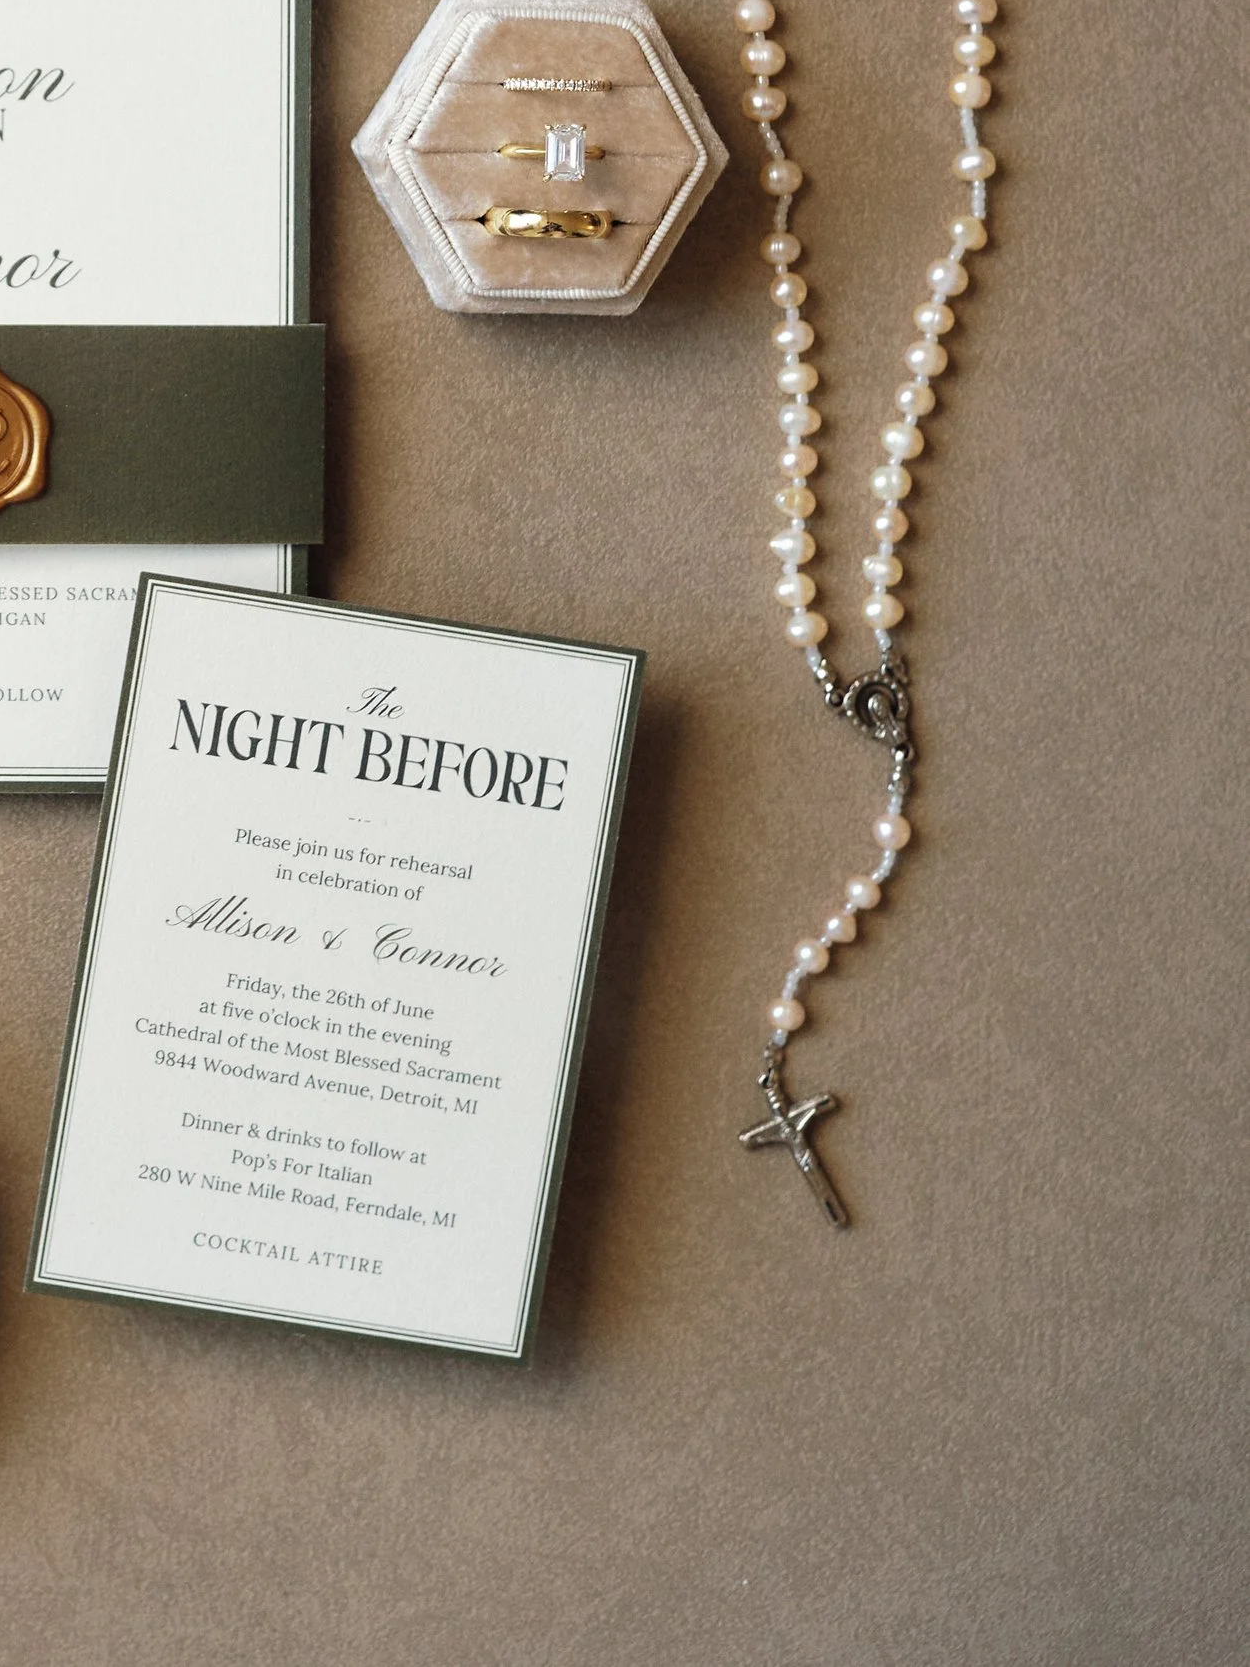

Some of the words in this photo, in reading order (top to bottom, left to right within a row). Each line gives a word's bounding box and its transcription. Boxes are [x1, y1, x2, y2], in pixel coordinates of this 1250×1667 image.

[345, 685, 405, 720] The
[168, 698, 345, 775] NIGHT
[353, 727, 569, 812] BEFORE
[234, 828, 292, 852] Please
[292, 837, 328, 858] join
[334, 847, 354, 862] us
[358, 847, 387, 866] for
[389, 854, 473, 880] rehearsal
[275, 863, 293, 881] in
[297, 870, 399, 898] celebration
[403, 885, 425, 902] of
[164, 894, 302, 945] Allison
[322, 927, 348, 950] &
[372, 923, 507, 978] Connor
[226, 972, 286, 1001] Friday,
[292, 983, 321, 1003] the
[325, 988, 366, 1010] 26th
[370, 997, 392, 1013] of
[392, 999, 435, 1021] June
[135, 1017, 223, 1045] Cathedral
[227, 1032, 248, 1049] of
[250, 1035, 280, 1055] the
[283, 1040, 329, 1063] Most
[334, 1048, 402, 1074] Blessed
[405, 1060, 502, 1090] Sacrament
[154, 1049, 197, 1070] 9844
[203, 1056, 300, 1087] Woodward
[303, 1074, 374, 1101] Avenue,
[379, 1085, 448, 1114] Detroit,
[453, 1097, 479, 1115] MI
[231, 1148, 278, 1173] Pop's
[282, 1157, 314, 1176] For
[317, 1162, 372, 1186] Italian
[138, 1164, 172, 1184] 280
[177, 1169, 197, 1187] W
[200, 1174, 243, 1195] Nine
[247, 1181, 286, 1202] Mile
[290, 1187, 339, 1213] Road,
[345, 1196, 426, 1226] Ferndale,
[431, 1210, 457, 1229] MI
[192, 1232, 300, 1262] COCKTAIL
[307, 1250, 383, 1275] ATTIRE
